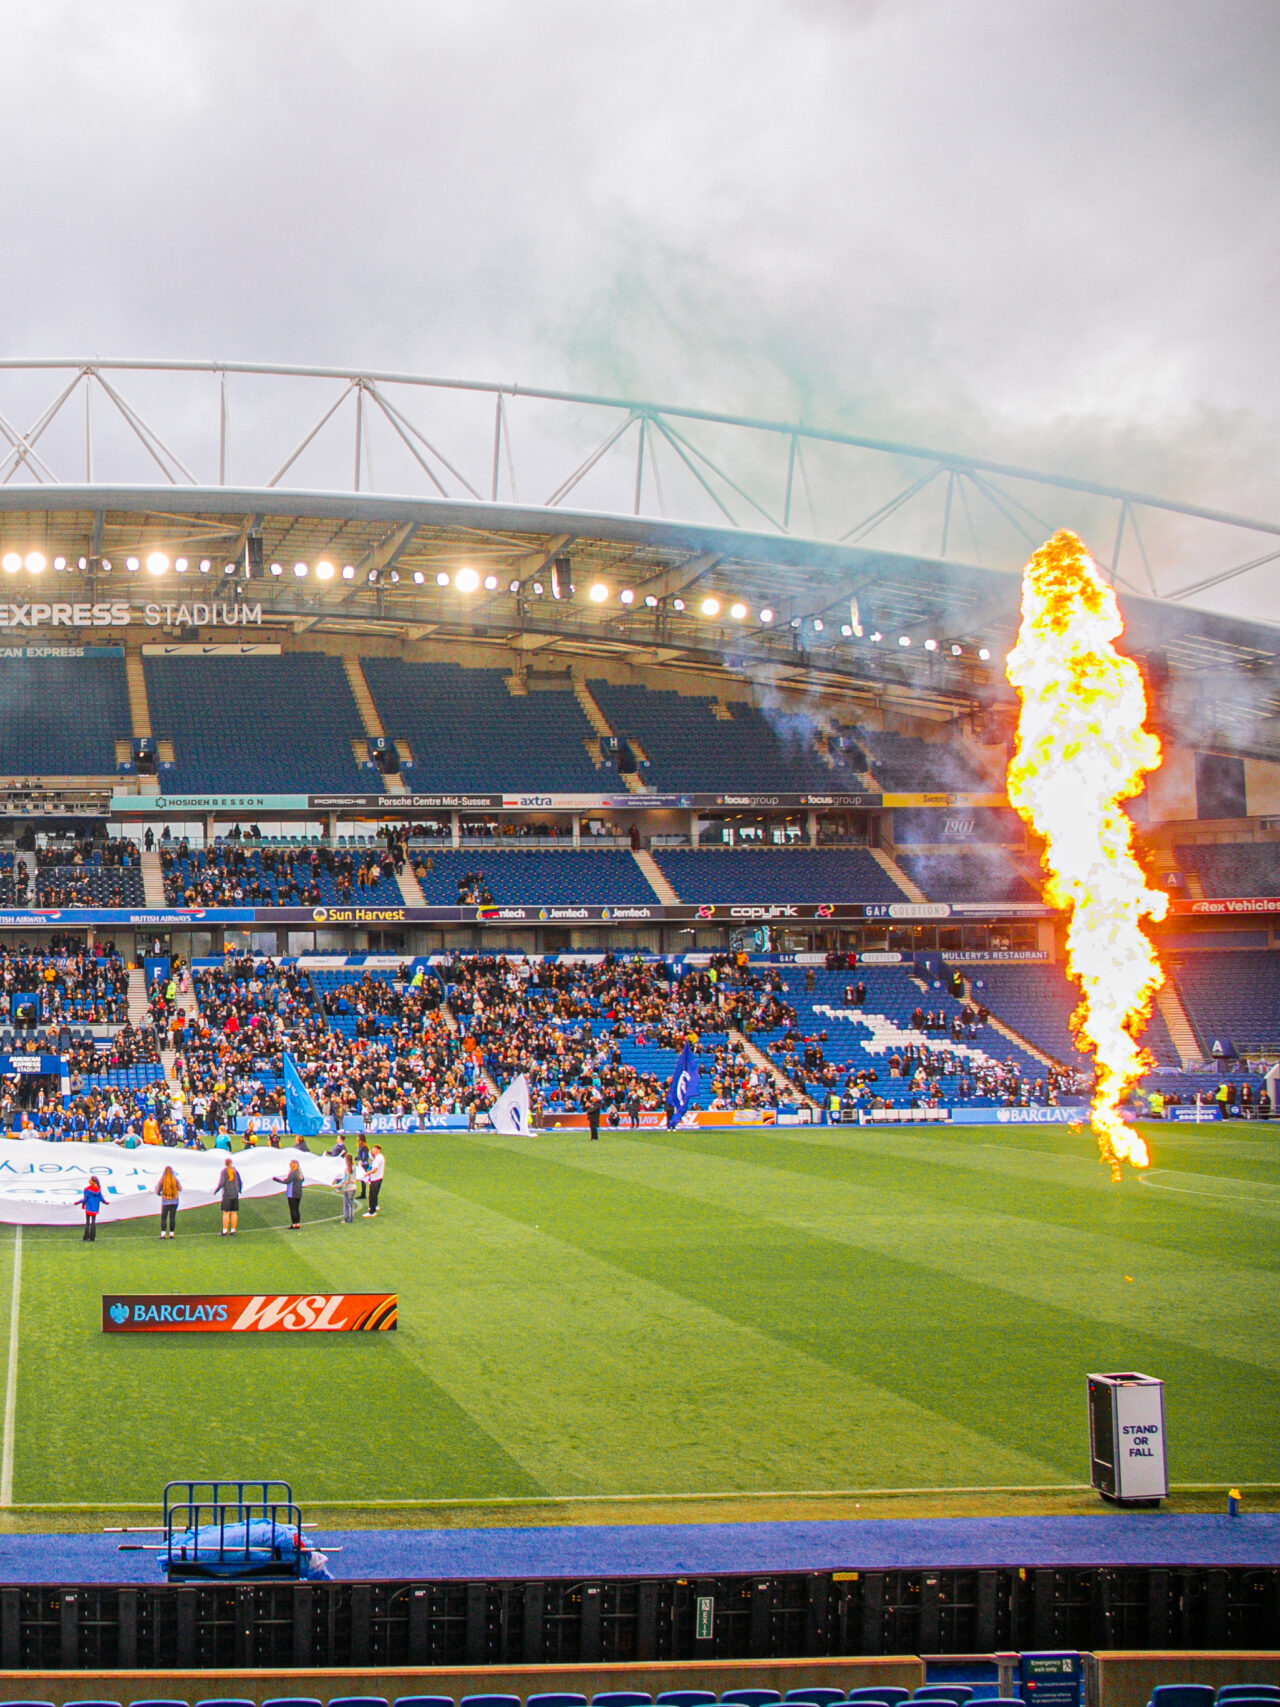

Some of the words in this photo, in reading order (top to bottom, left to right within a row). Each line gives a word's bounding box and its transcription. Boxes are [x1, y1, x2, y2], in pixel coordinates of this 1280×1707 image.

[144, 603, 262, 626] STADIUM
[26, 647, 84, 658] EXPRESS
[140, 738, 148, 748] F
[377, 738, 385, 748] G
[610, 737, 618, 747] H
[168, 798, 210, 807] HOSIDEN
[378, 797, 412, 807] Porsche
[413, 797, 441, 807] Centre
[442, 797, 491, 807] Mid-Sussex
[520, 795, 552, 806] axtra
[943, 820, 975, 833] 1901
[1167, 873, 1177, 884] A
[731, 905, 799, 919] copylink
[866, 905, 887, 916] GAP
[892, 905, 948, 917] SOLUTIONS
[1201, 901, 1225, 912] Rex
[329, 909, 354, 920] Sun
[356, 908, 405, 920] Harvest
[549, 908, 588, 918] Jemtech
[611, 908, 651, 918] Jemtech
[16, 916, 47, 924] AIRWAYS
[130, 915, 160, 923] BRITISH
[161, 915, 192, 923] AIRWAYS
[941, 952, 990, 960] MULLERY'S
[992, 951, 1048, 960] RESTAURANT
[154, 967, 162, 978] F
[673, 963, 682, 974] H
[1212, 1040, 1223, 1052] A
[1011, 1109, 1078, 1121] BARCLAYS
[133, 1304, 228, 1321] BARCLAYS
[231, 1296, 348, 1330] WSL
[1122, 1425, 1158, 1434] STAND
[1133, 1437, 1148, 1445] OR
[1129, 1448, 1154, 1457] FALL
